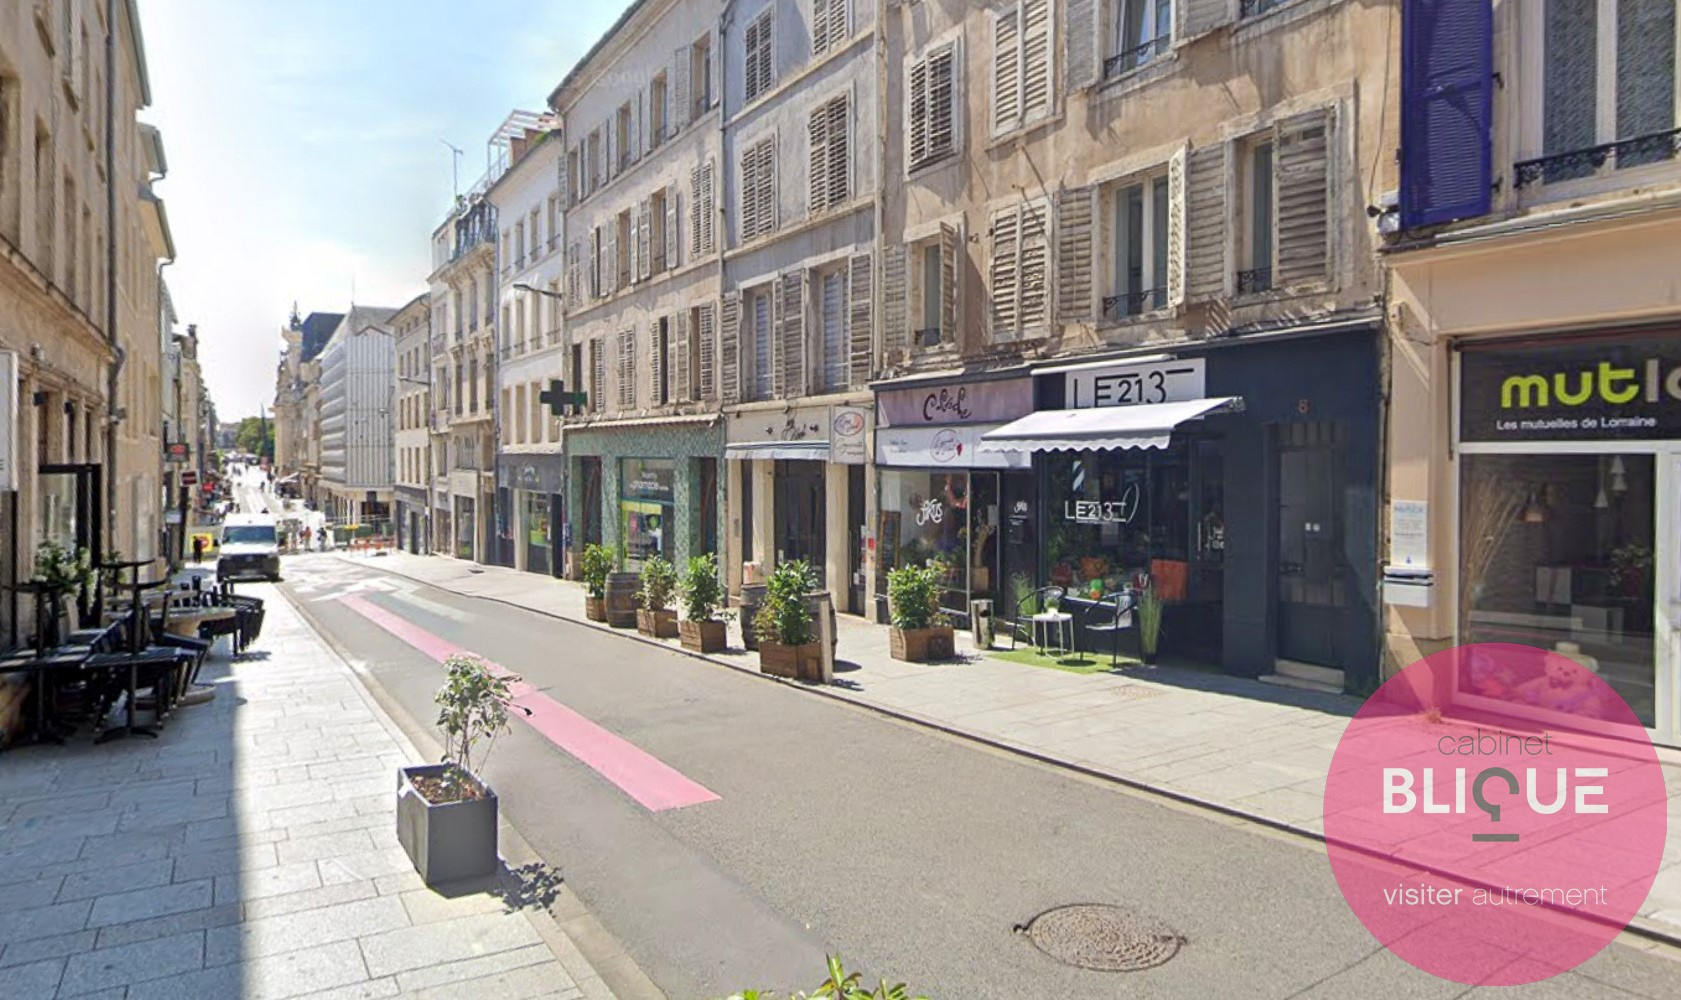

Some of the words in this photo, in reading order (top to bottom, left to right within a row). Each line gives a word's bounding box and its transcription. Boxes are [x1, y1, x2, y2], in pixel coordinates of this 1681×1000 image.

[1496, 420, 1517, 431] Les
[1521, 418, 1578, 430] mutuelles
[1581, 417, 1597, 429] de
[1601, 416, 1656, 428] Lorraine
